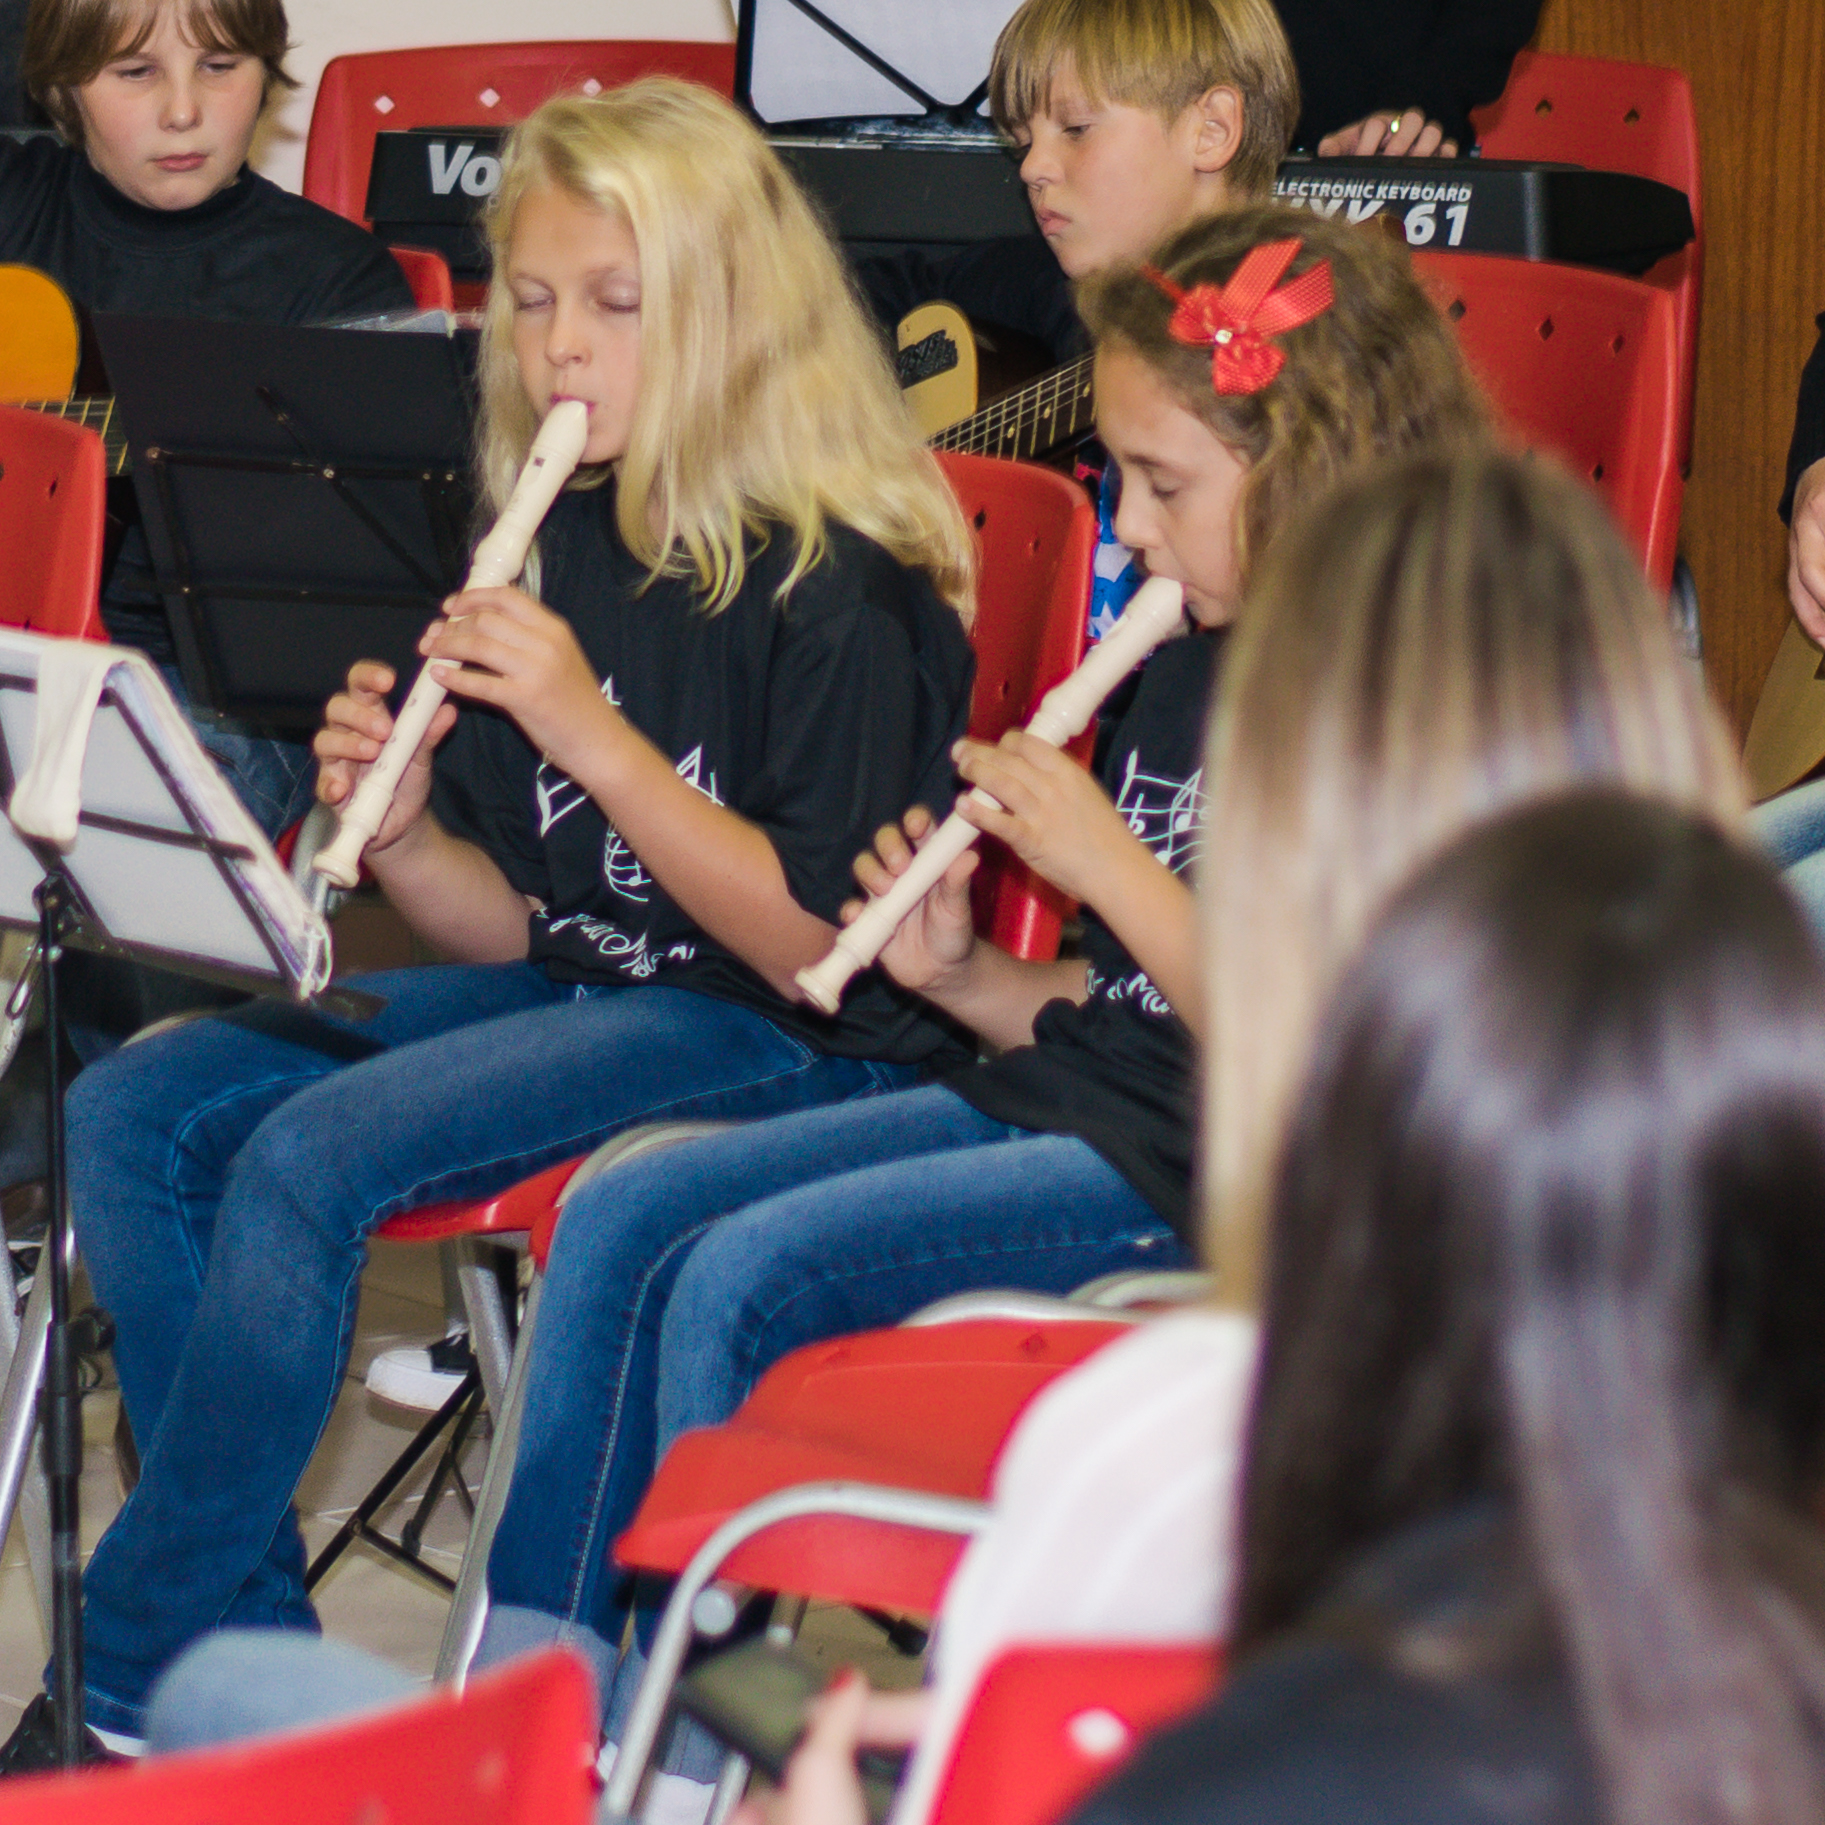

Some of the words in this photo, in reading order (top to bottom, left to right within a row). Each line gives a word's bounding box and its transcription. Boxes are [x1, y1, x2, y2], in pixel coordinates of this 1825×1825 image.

[427, 139, 503, 197] Vo
[1376, 180, 1473, 202] KEYBOARD
[1404, 201, 1470, 246] 61
